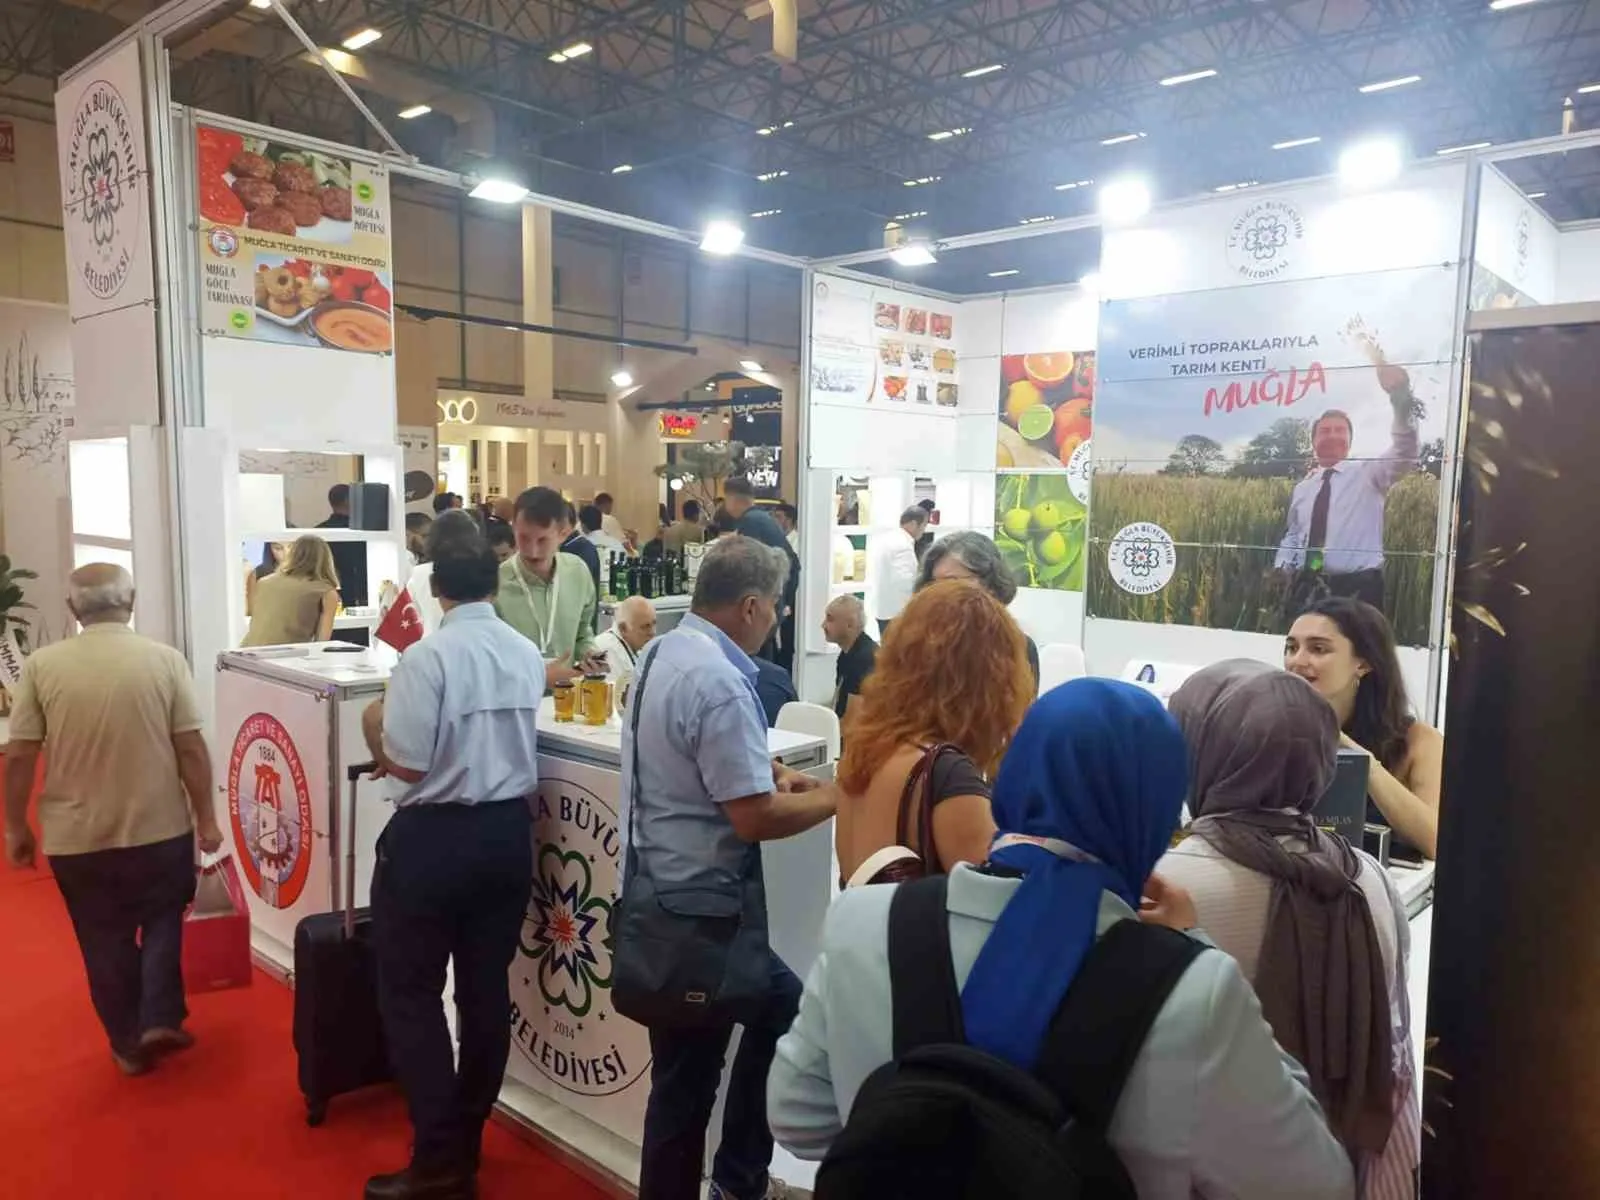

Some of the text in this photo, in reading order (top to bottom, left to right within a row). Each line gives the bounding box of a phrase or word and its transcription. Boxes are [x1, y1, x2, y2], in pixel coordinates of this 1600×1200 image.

[1128, 334, 1319, 360] VERİMLİ TOPRAKLARIYLA
[1171, 355, 1267, 376] TARIM KENTİ
[1203, 361, 1327, 417] MUĞLA
[258, 744, 277, 763] 1884
[560, 795, 620, 868] BÜYÜ
[552, 1019, 575, 1040] 2014
[508, 1000, 627, 1086] BELEDİYESİ
